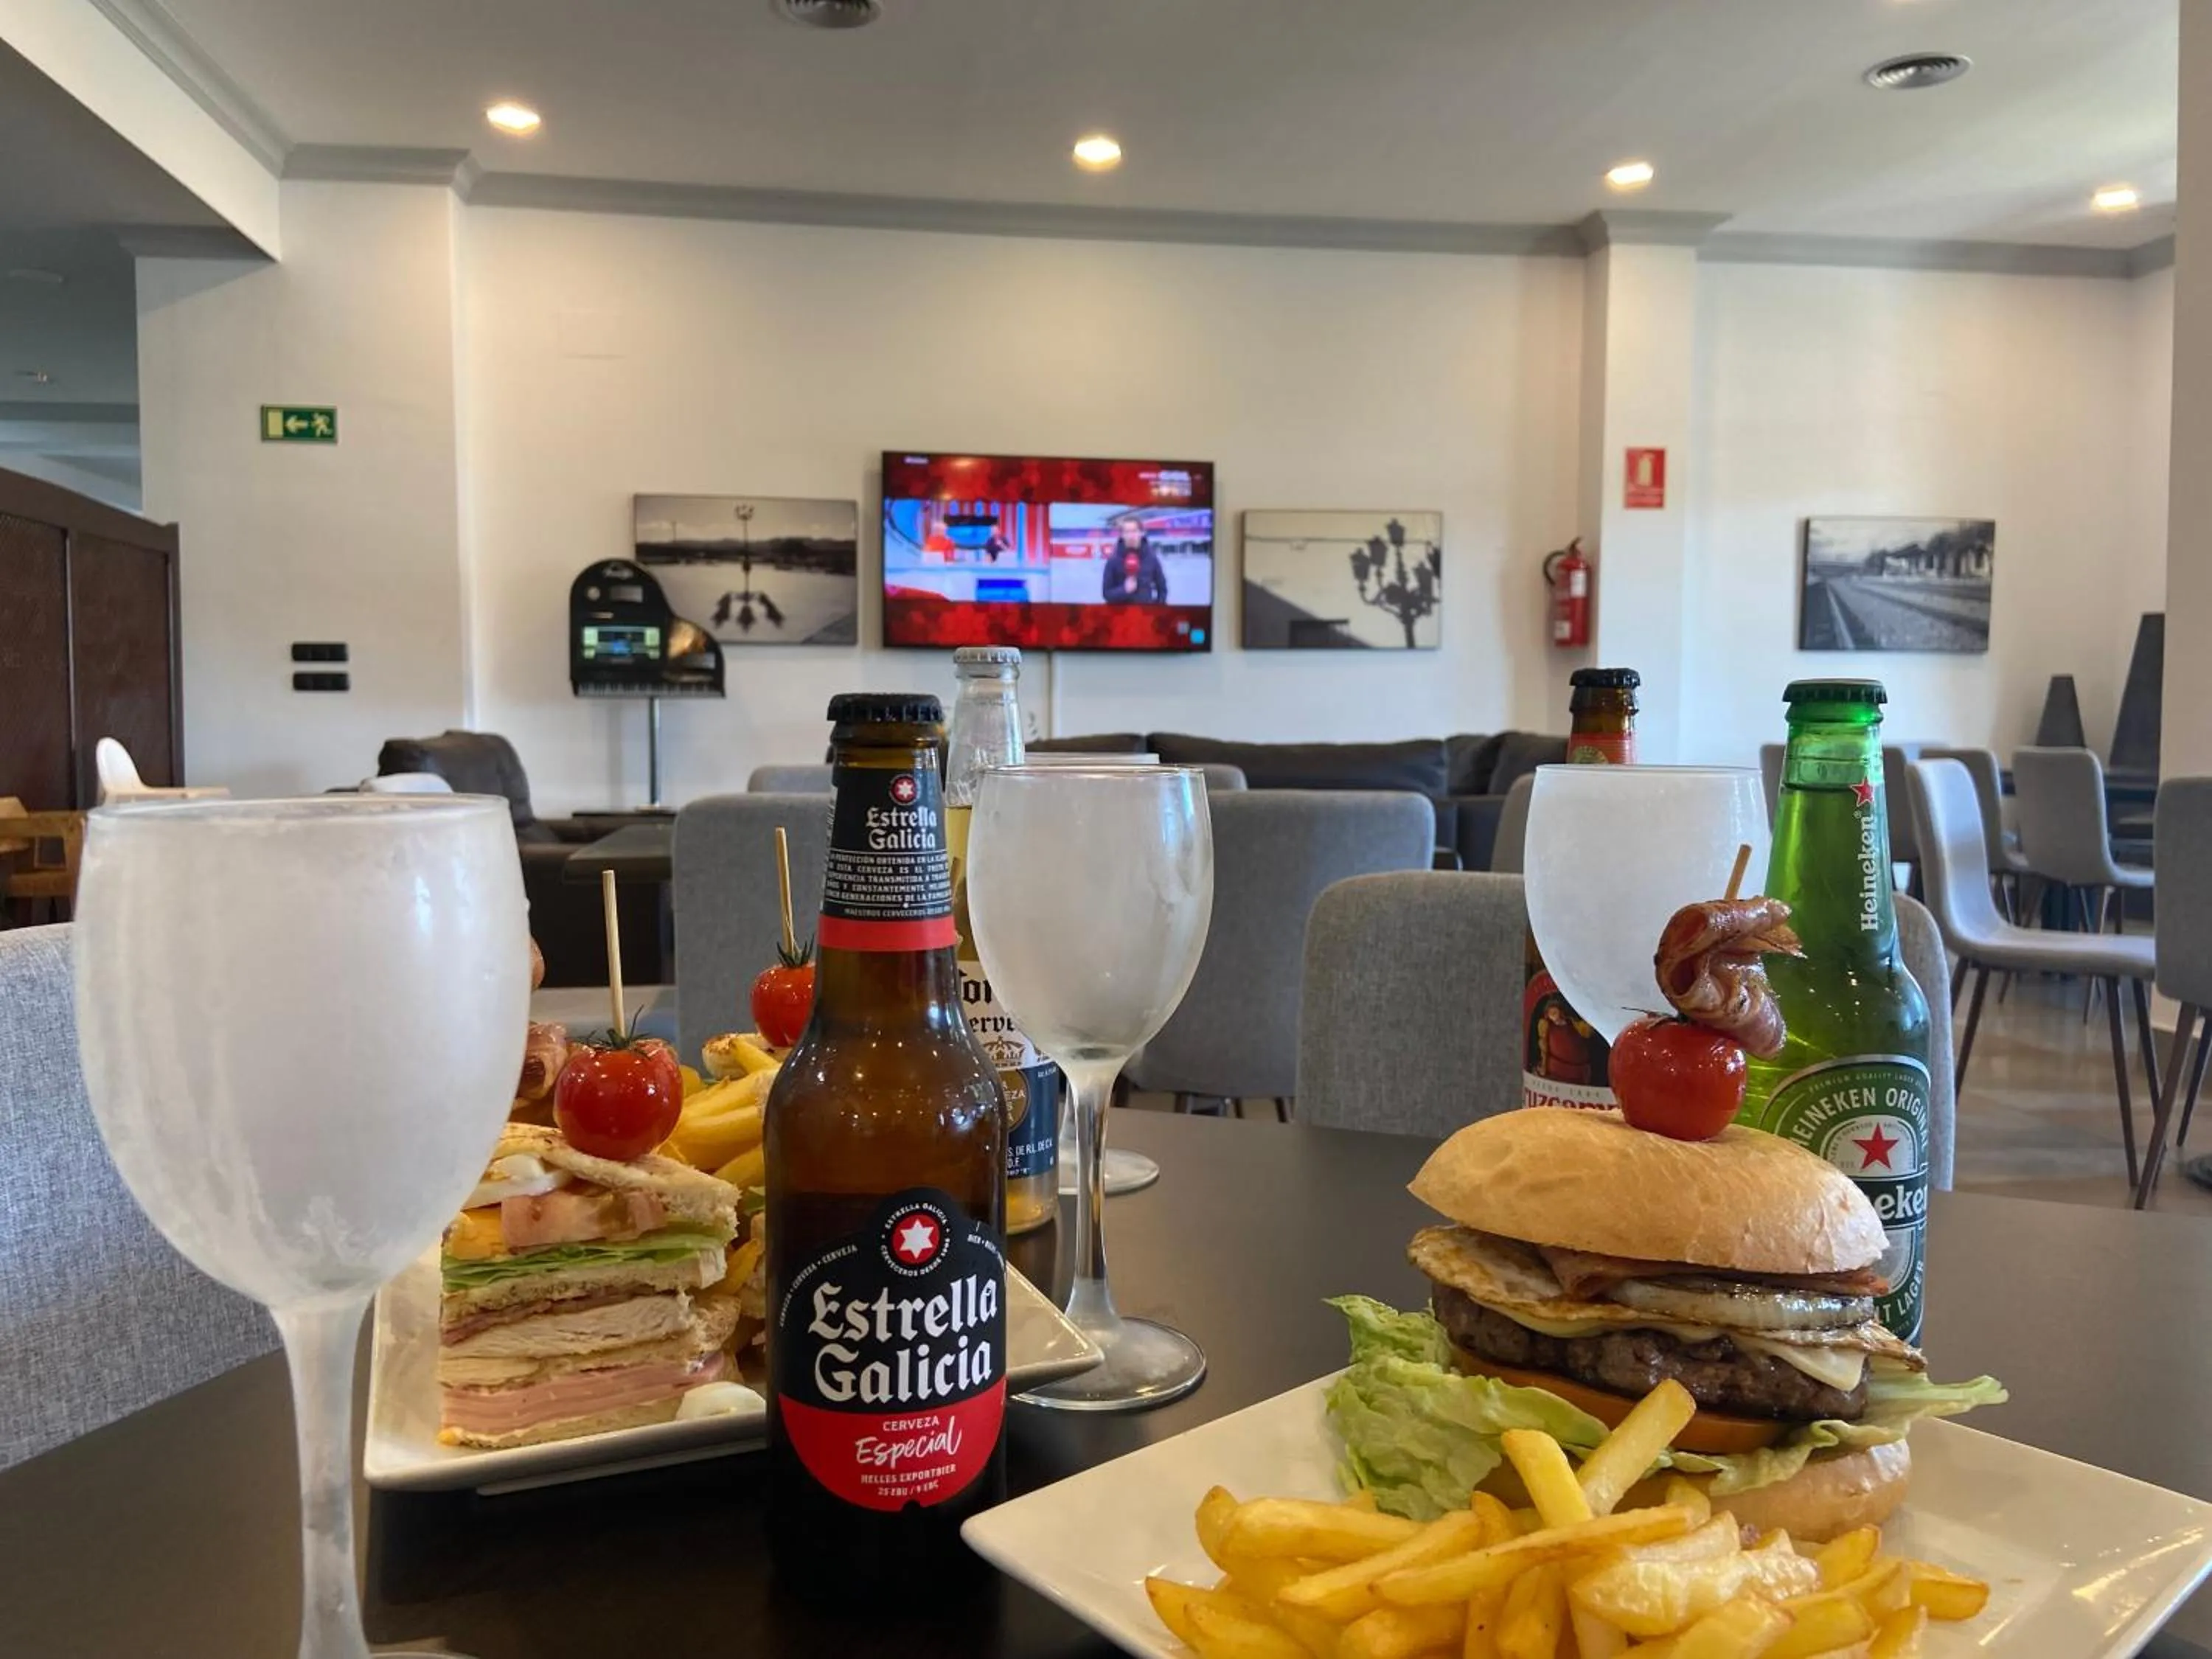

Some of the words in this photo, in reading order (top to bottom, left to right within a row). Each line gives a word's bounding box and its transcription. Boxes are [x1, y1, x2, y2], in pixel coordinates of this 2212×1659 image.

[865, 806, 937, 827] Estrella
[869, 827, 936, 850] Galicia
[857, 865, 894, 874] CERVEZA
[899, 866, 909, 874] ES
[867, 874, 923, 883] TRANSMITIDA
[1857, 813, 1879, 932] Heineken
[841, 891, 903, 902] GENERACIONES
[903, 894, 915, 902] DE
[852, 883, 925, 893] CONSTANTEMENTE
[884, 1203, 920, 1229] ESTRELLA
[922, 1203, 947, 1225] GALICIA
[807, 1273, 998, 1343] Estrella
[814, 1335, 992, 1404] Galicia
[883, 1415, 940, 1432] CERVEZA
[855, 1415, 962, 1470] Especial
[860, 1474, 897, 1484] HELLES
[899, 1464, 957, 1483] EXPORTBIER
